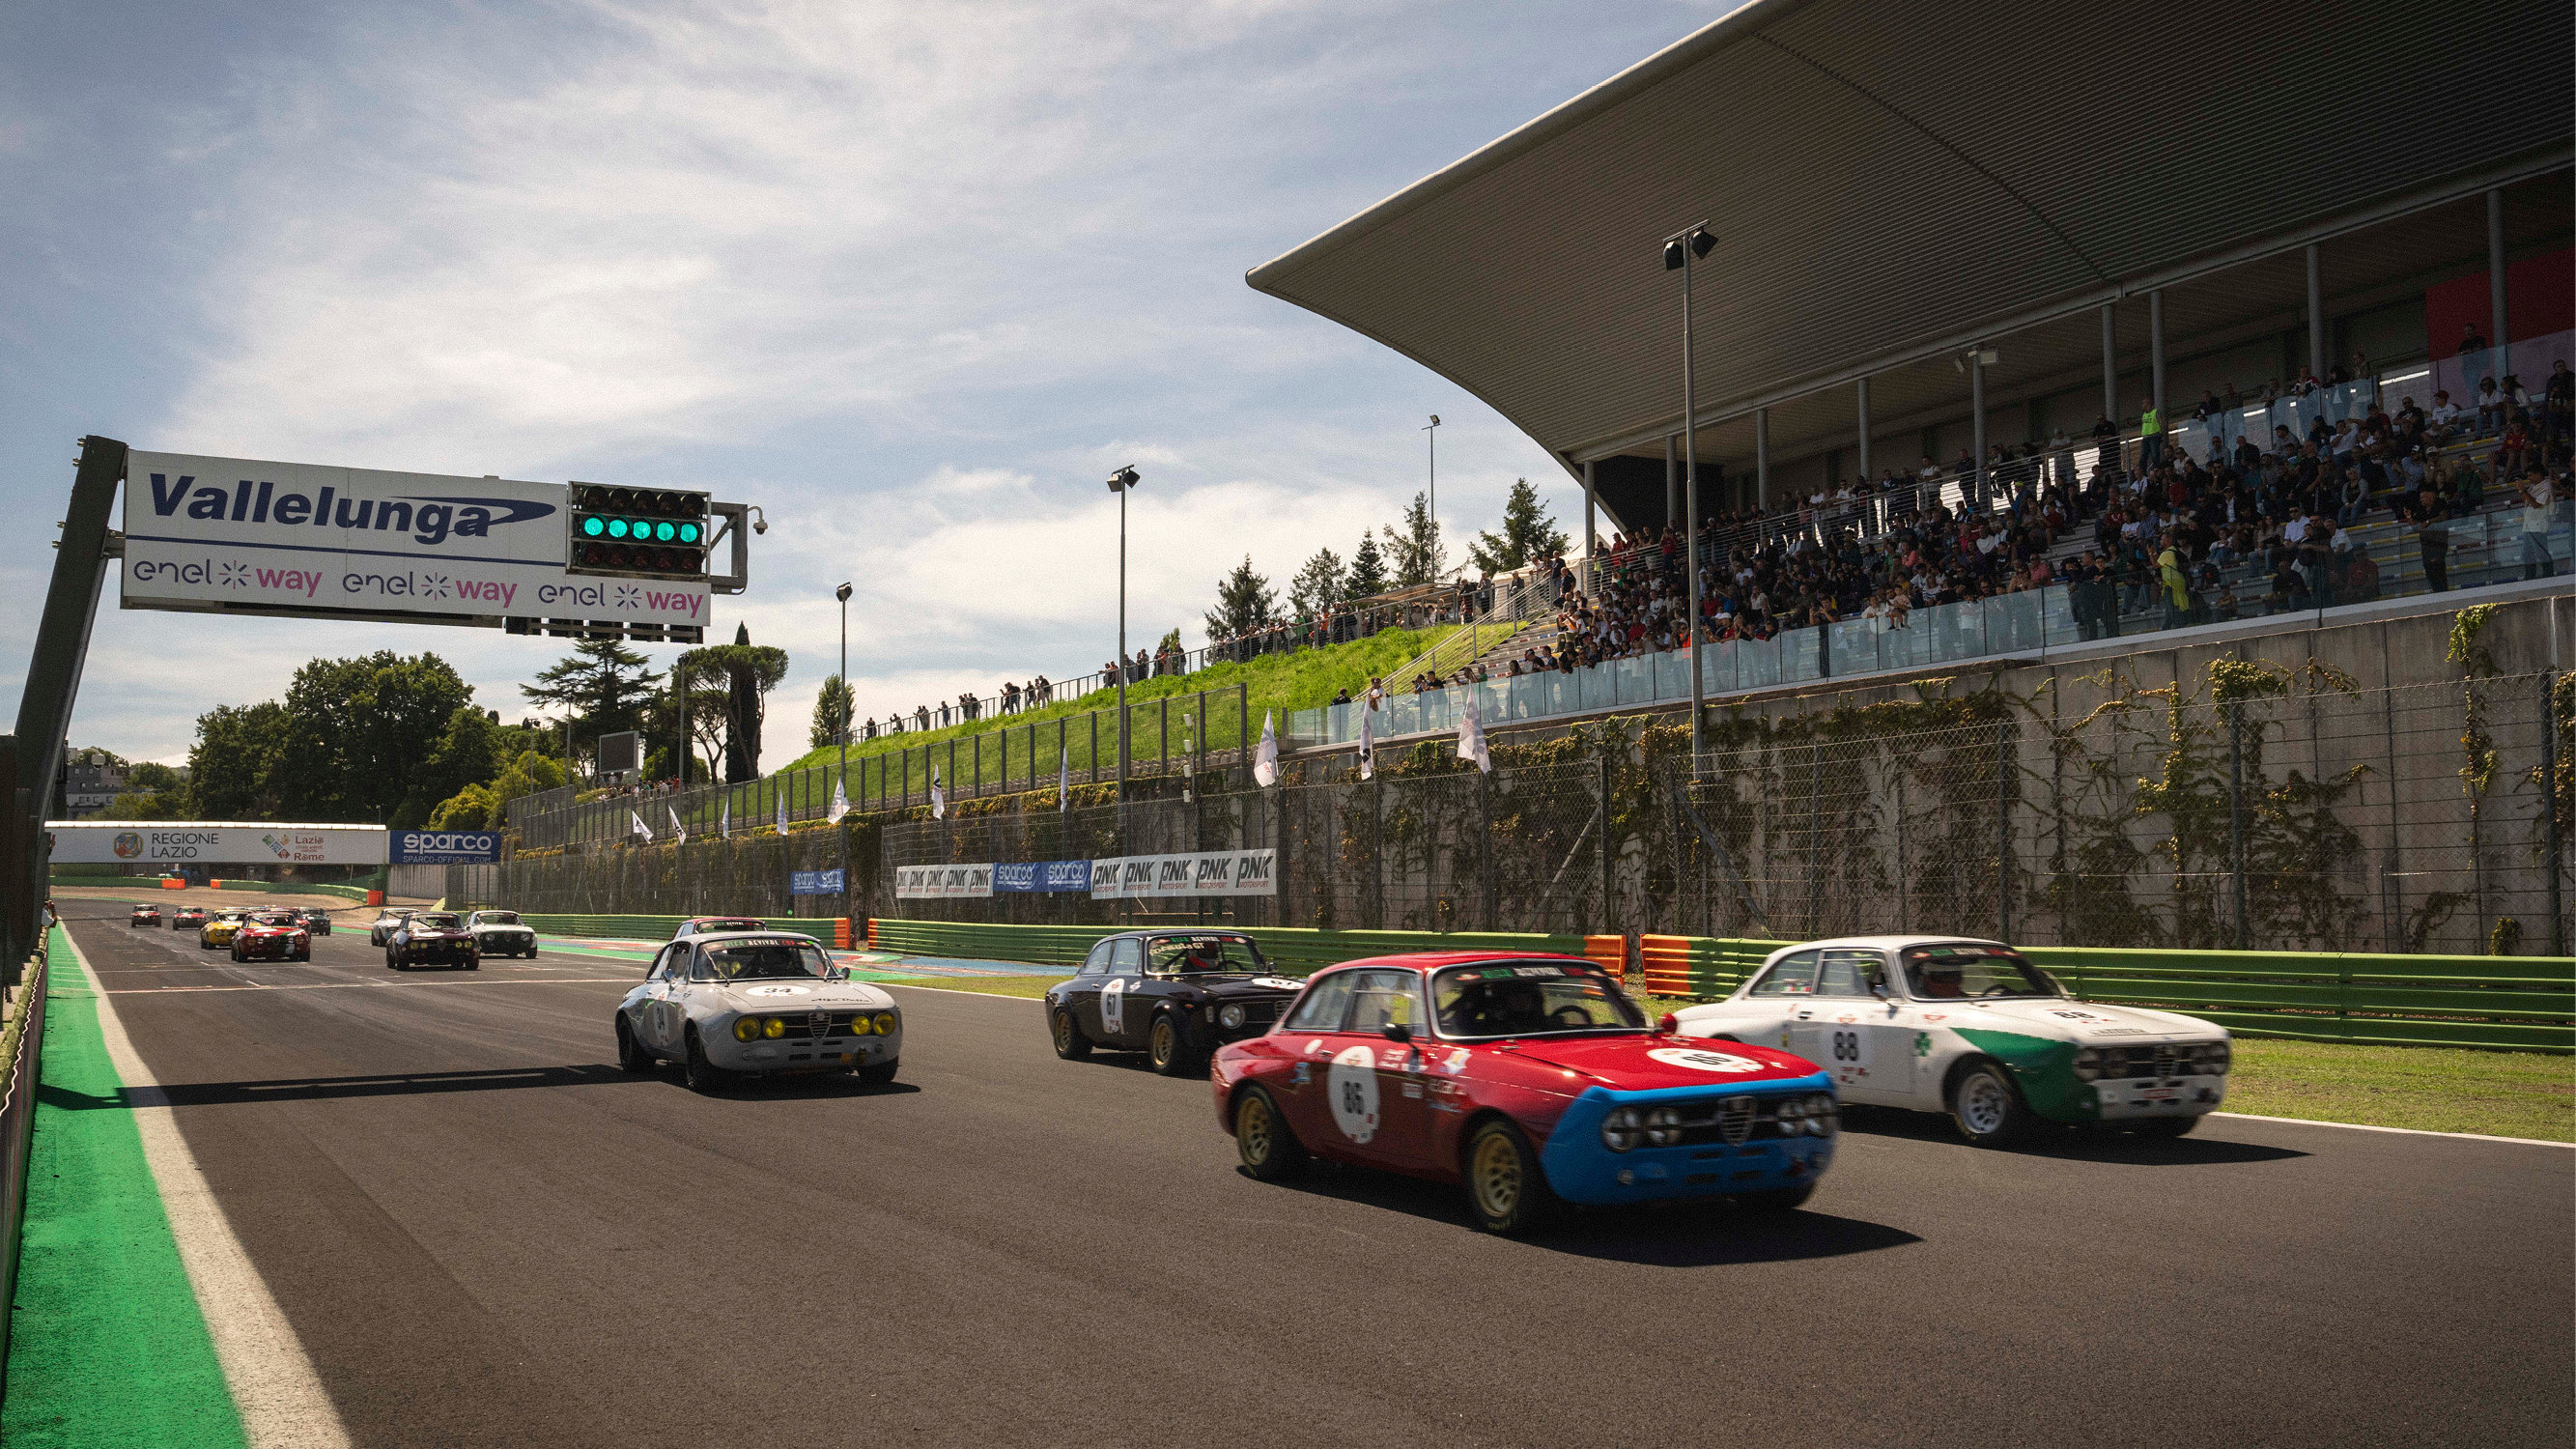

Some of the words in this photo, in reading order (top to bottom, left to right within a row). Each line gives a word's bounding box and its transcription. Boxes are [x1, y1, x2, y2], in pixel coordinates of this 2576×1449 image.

[150, 473, 491, 545] Vallelunga
[133, 558, 212, 584] enel
[256, 568, 323, 598] way
[342, 571, 415, 596] enel
[455, 580, 518, 609] way
[538, 582, 606, 607] enel
[646, 591, 703, 619] way
[152, 833, 219, 844] REGIONE
[152, 846, 197, 858] LAZIO
[404, 833, 492, 854] sparco
[1834, 1031, 1858, 1061] 88
